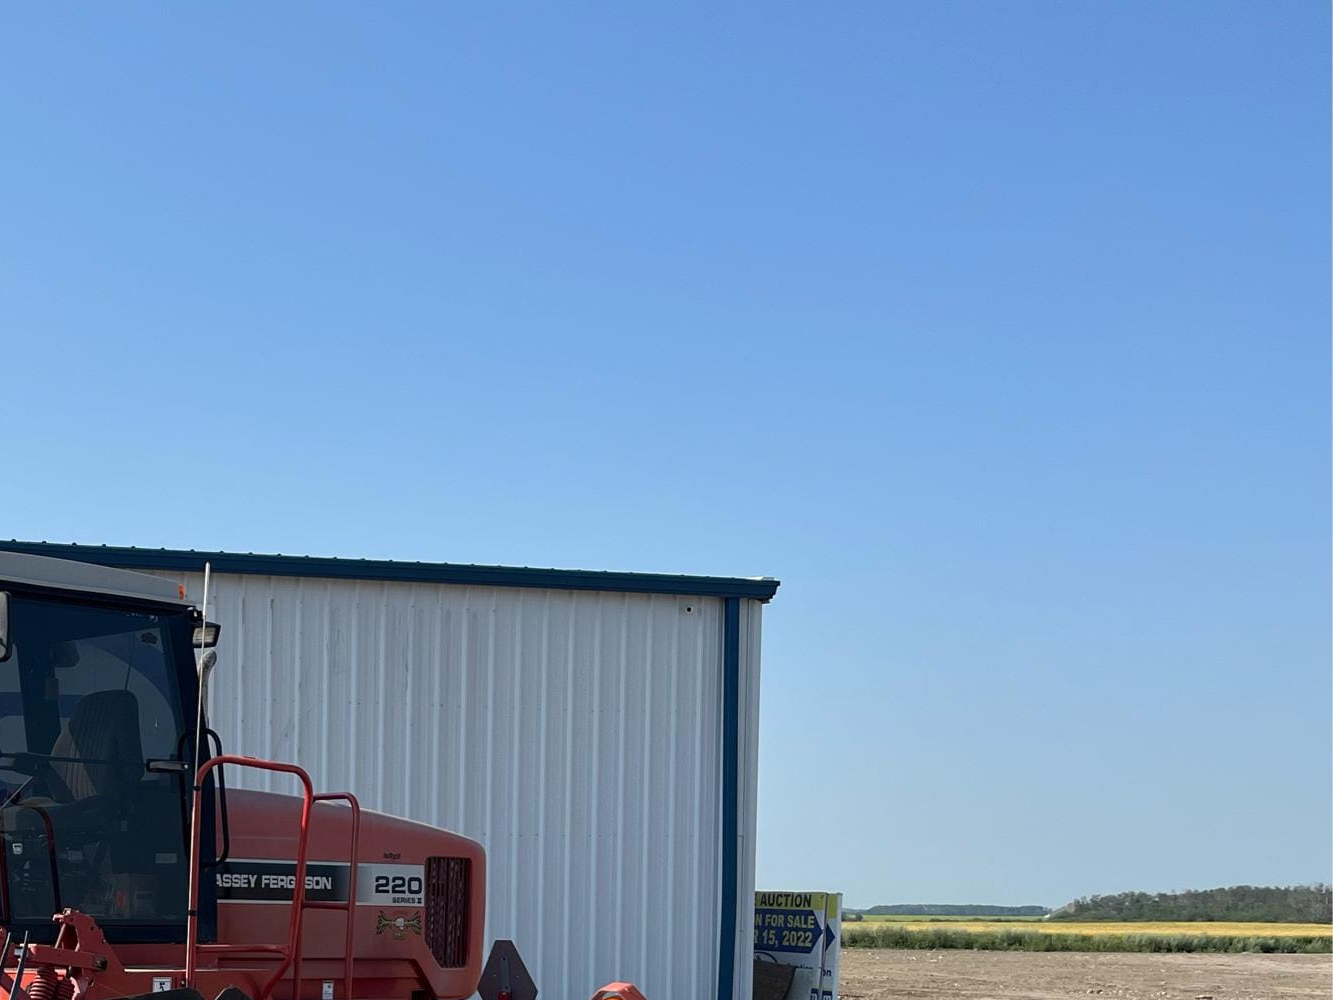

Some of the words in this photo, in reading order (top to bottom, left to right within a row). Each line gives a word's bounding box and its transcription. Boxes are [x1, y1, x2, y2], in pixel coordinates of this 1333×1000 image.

[216, 873, 258, 888] ASSEY
[261, 875, 332, 890] FERGSON
[375, 876, 422, 894] 220
[392, 896, 416, 904] SERIES
[760, 893, 812, 908] AUCTION
[765, 914, 784, 928] FOR
[787, 914, 815, 929] SALE
[762, 929, 779, 948] 15,
[782, 931, 812, 947] 2022
